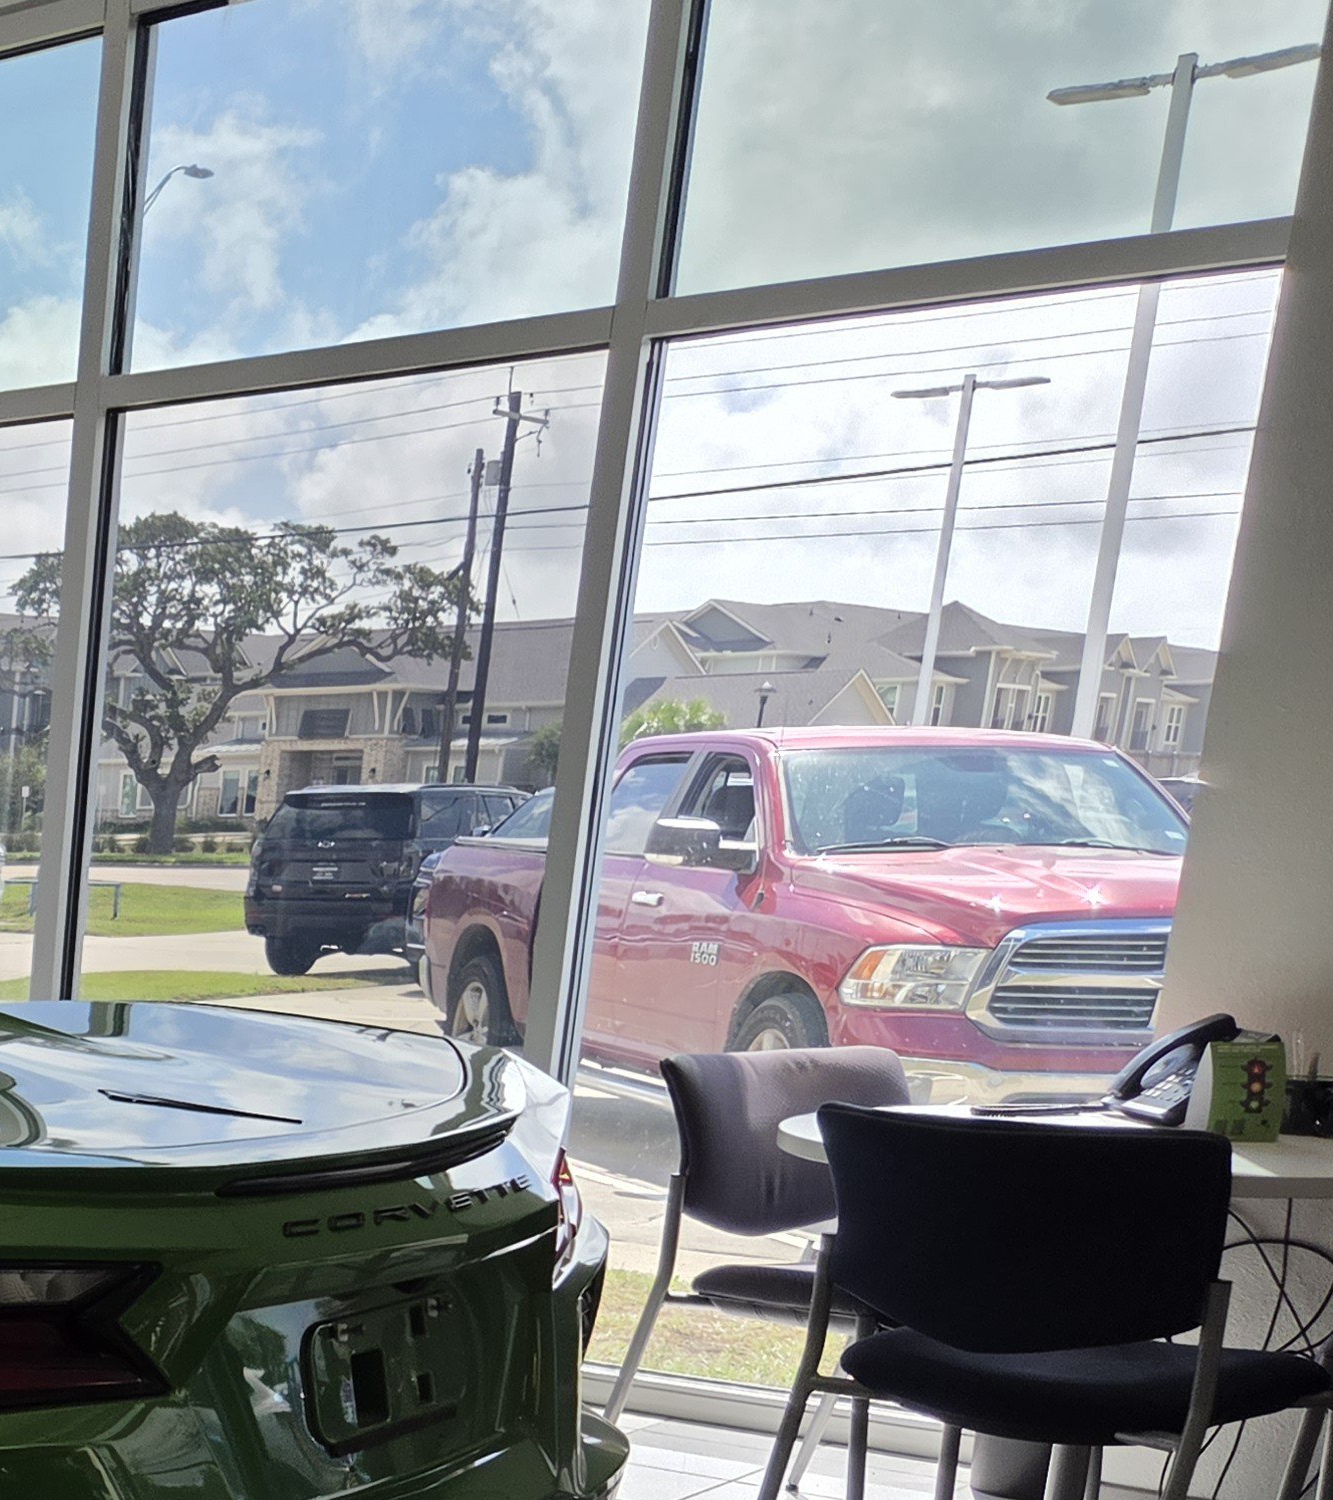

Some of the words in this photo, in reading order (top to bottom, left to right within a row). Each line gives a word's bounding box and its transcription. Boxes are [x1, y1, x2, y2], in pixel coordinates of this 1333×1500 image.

[692, 942, 718, 954] RAM
[690, 952, 717, 966] 1500
[283, 1174, 532, 1238] CORVETTE
